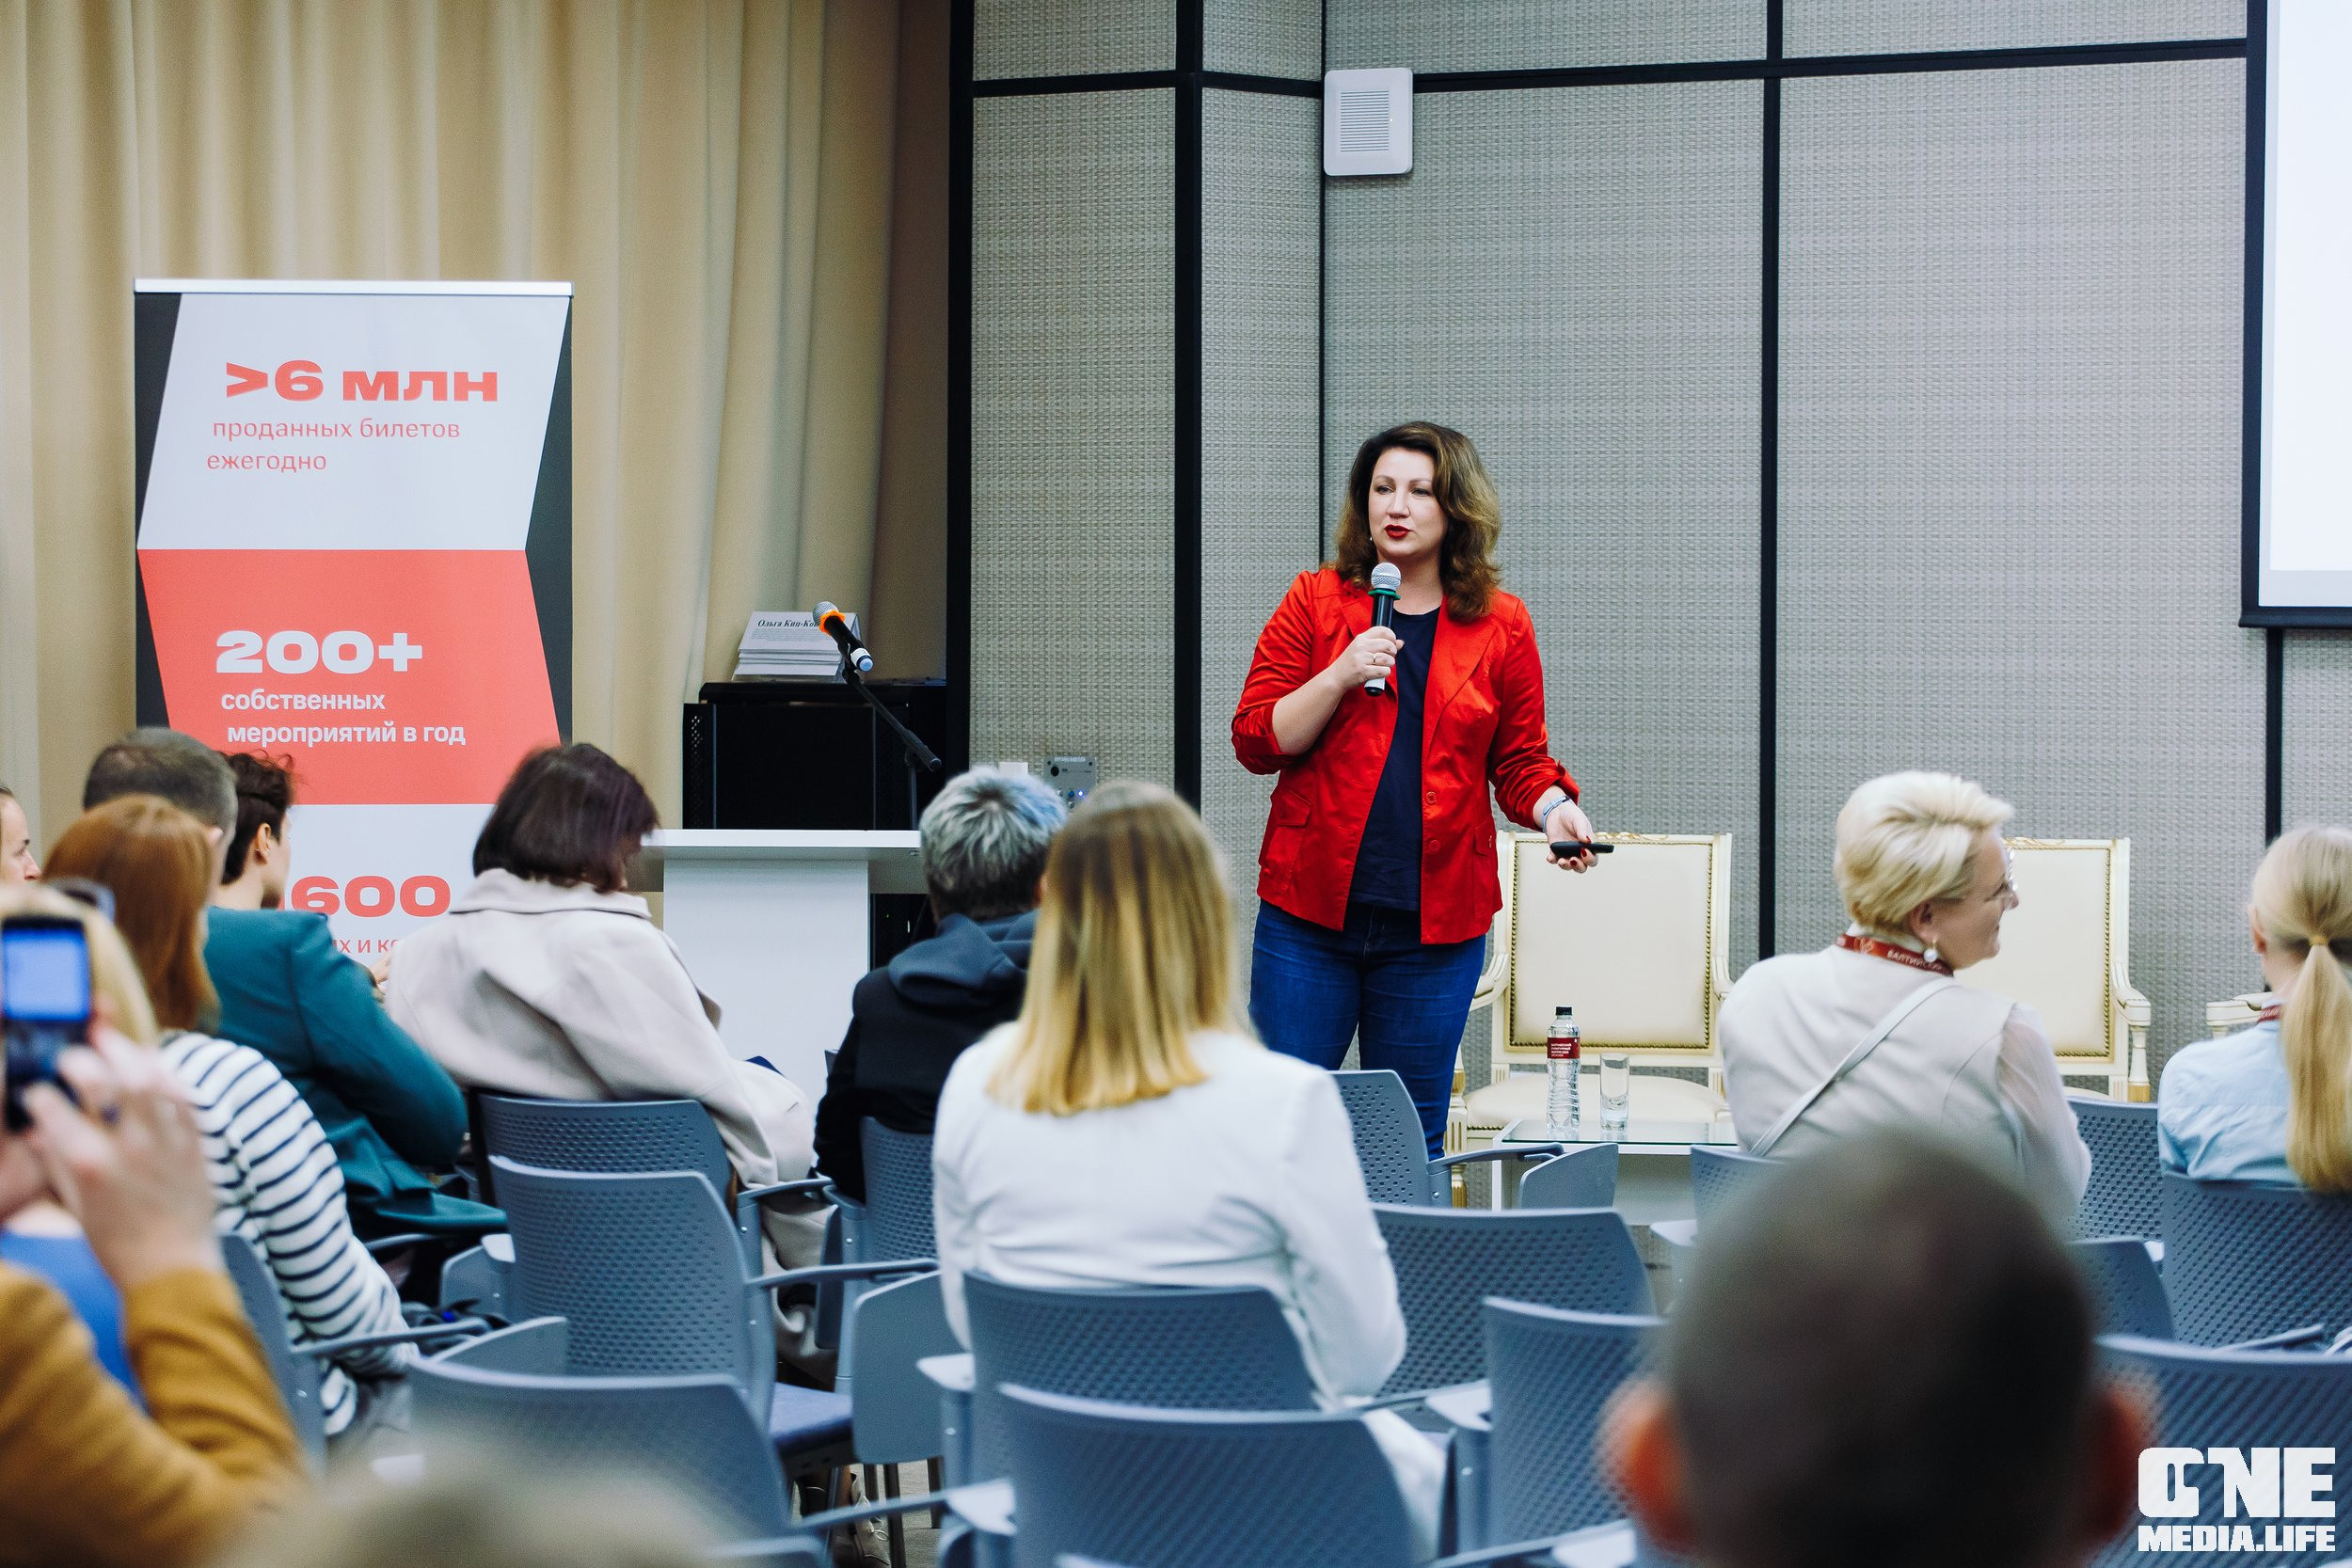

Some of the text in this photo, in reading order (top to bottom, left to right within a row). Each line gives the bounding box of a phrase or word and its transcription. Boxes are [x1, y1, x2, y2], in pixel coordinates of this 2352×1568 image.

[342, 371, 499, 403] млн
[213, 418, 461, 439] проданных билетов
[206, 453, 327, 472] ежегодно
[215, 630, 423, 674] 200+
[221, 689, 387, 711] собственных
[228, 721, 467, 748] мероприятий в год
[278, 875, 452, 918] 600
